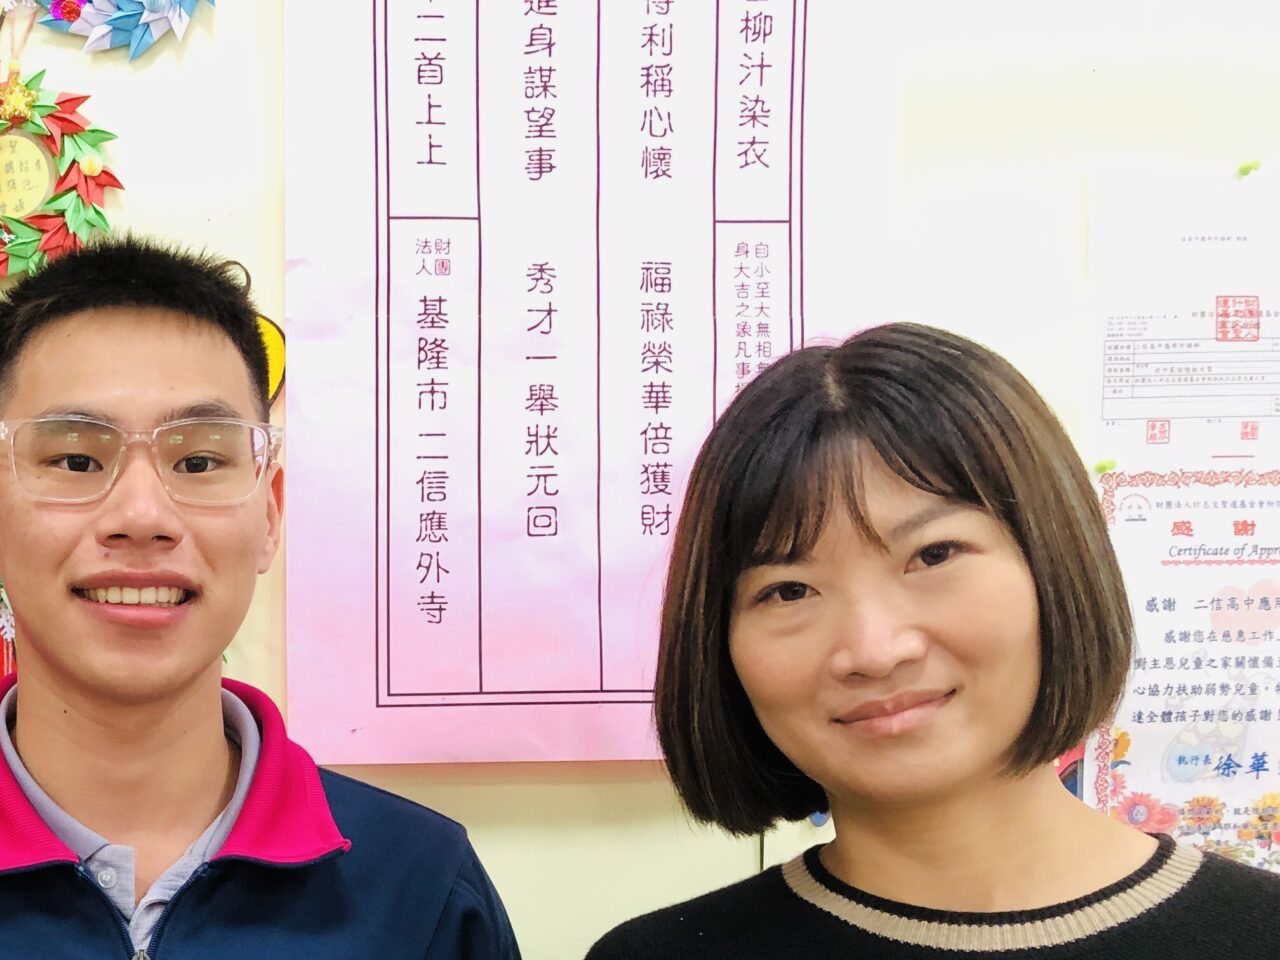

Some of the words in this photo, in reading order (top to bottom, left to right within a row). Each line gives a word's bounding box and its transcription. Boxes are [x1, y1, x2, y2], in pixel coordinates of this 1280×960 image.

[415, 296, 450, 624] 基隆市二信應外寺
[524, 262, 559, 537] 秀才一舉狀元回
[640, 261, 674, 536] 福祿榮華倍獲財
[1145, 597, 1176, 612] 感謝
[1169, 544, 1229, 559] Certificate
[1233, 543, 1248, 559] of
